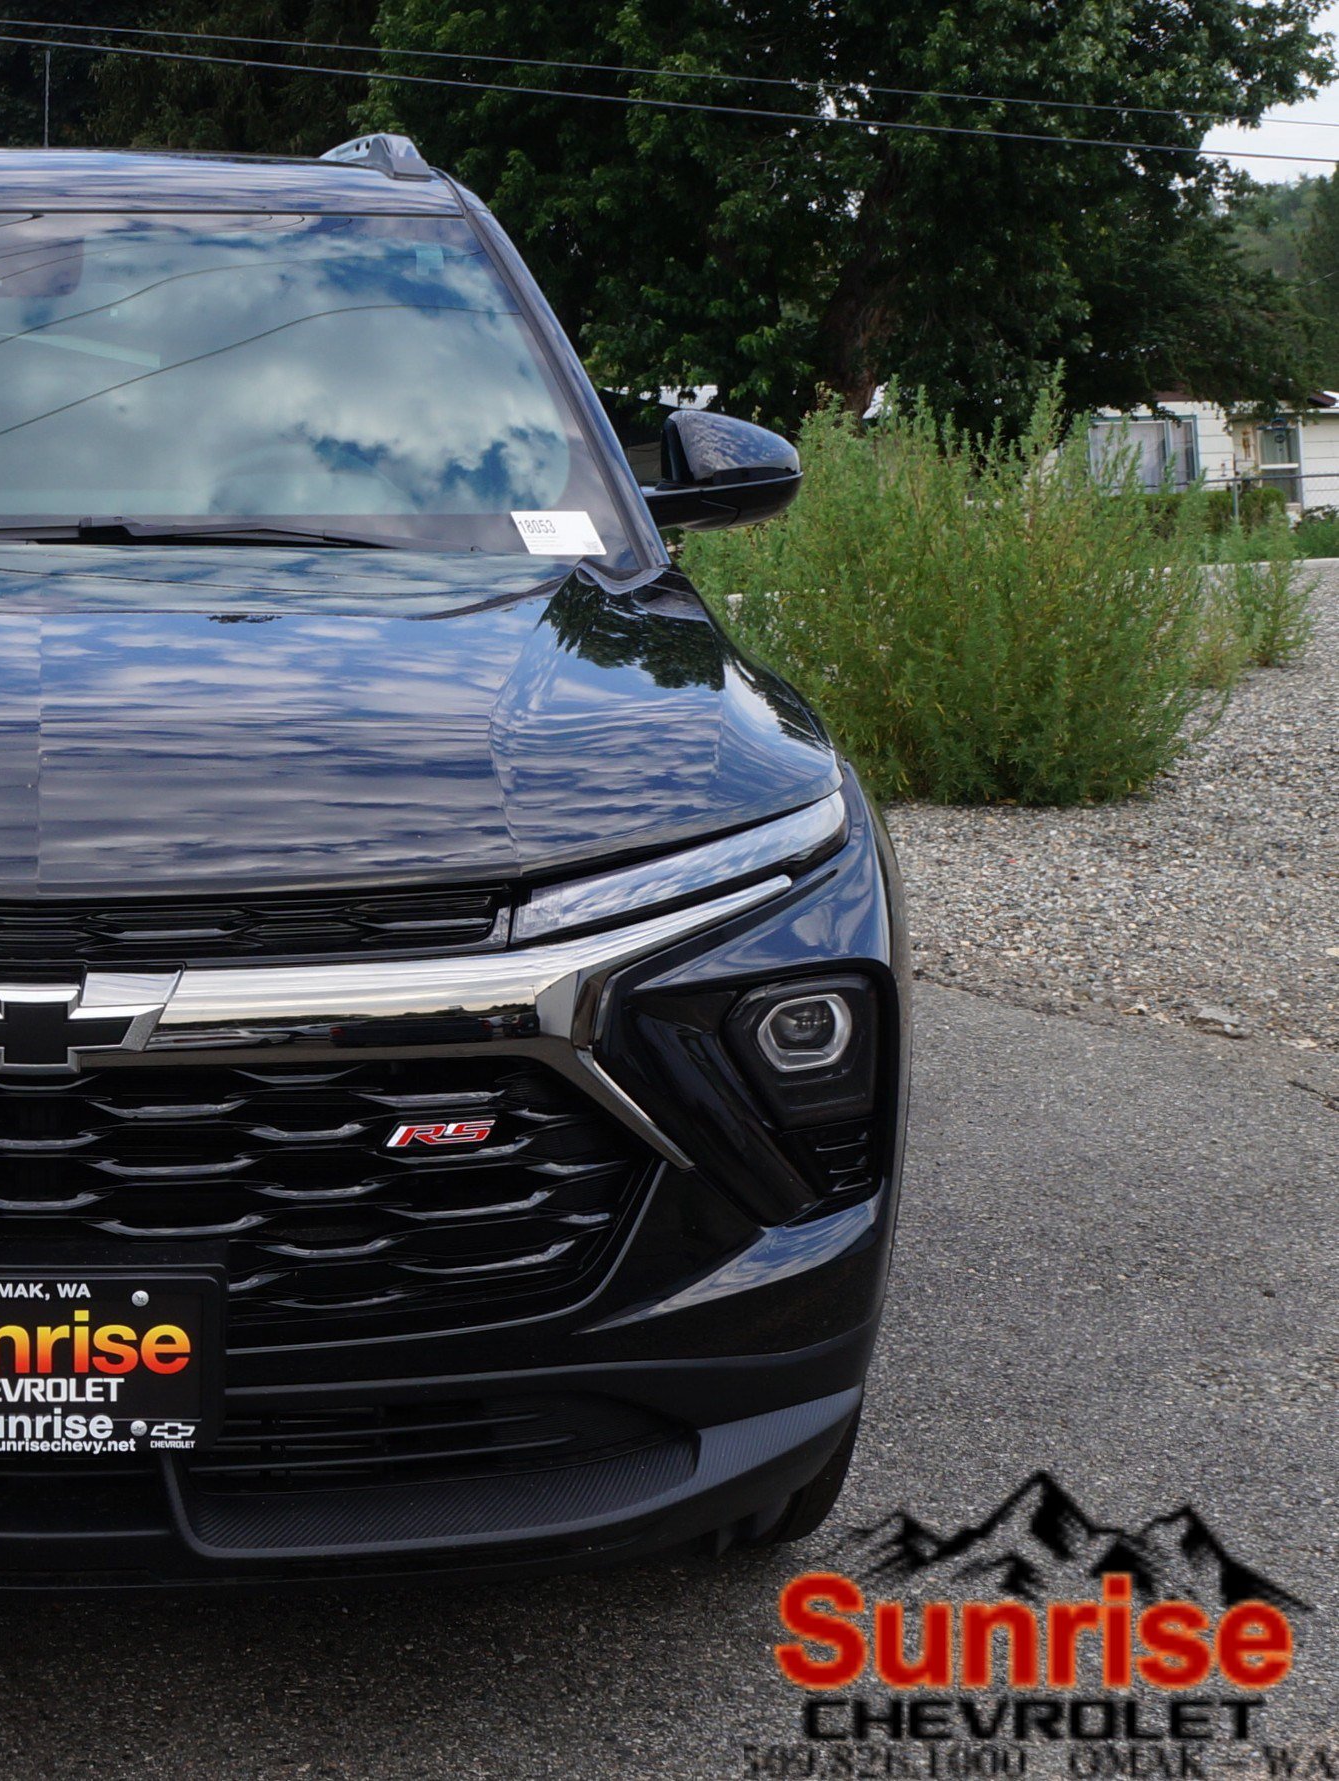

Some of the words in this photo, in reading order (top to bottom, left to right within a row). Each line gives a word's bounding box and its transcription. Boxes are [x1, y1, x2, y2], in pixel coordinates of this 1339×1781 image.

[518, 519, 557, 534] 18053
[386, 1119, 496, 1148] RS
[57, 1283, 91, 1298] WA
[150, 1440, 196, 1449] CHEVROLET
